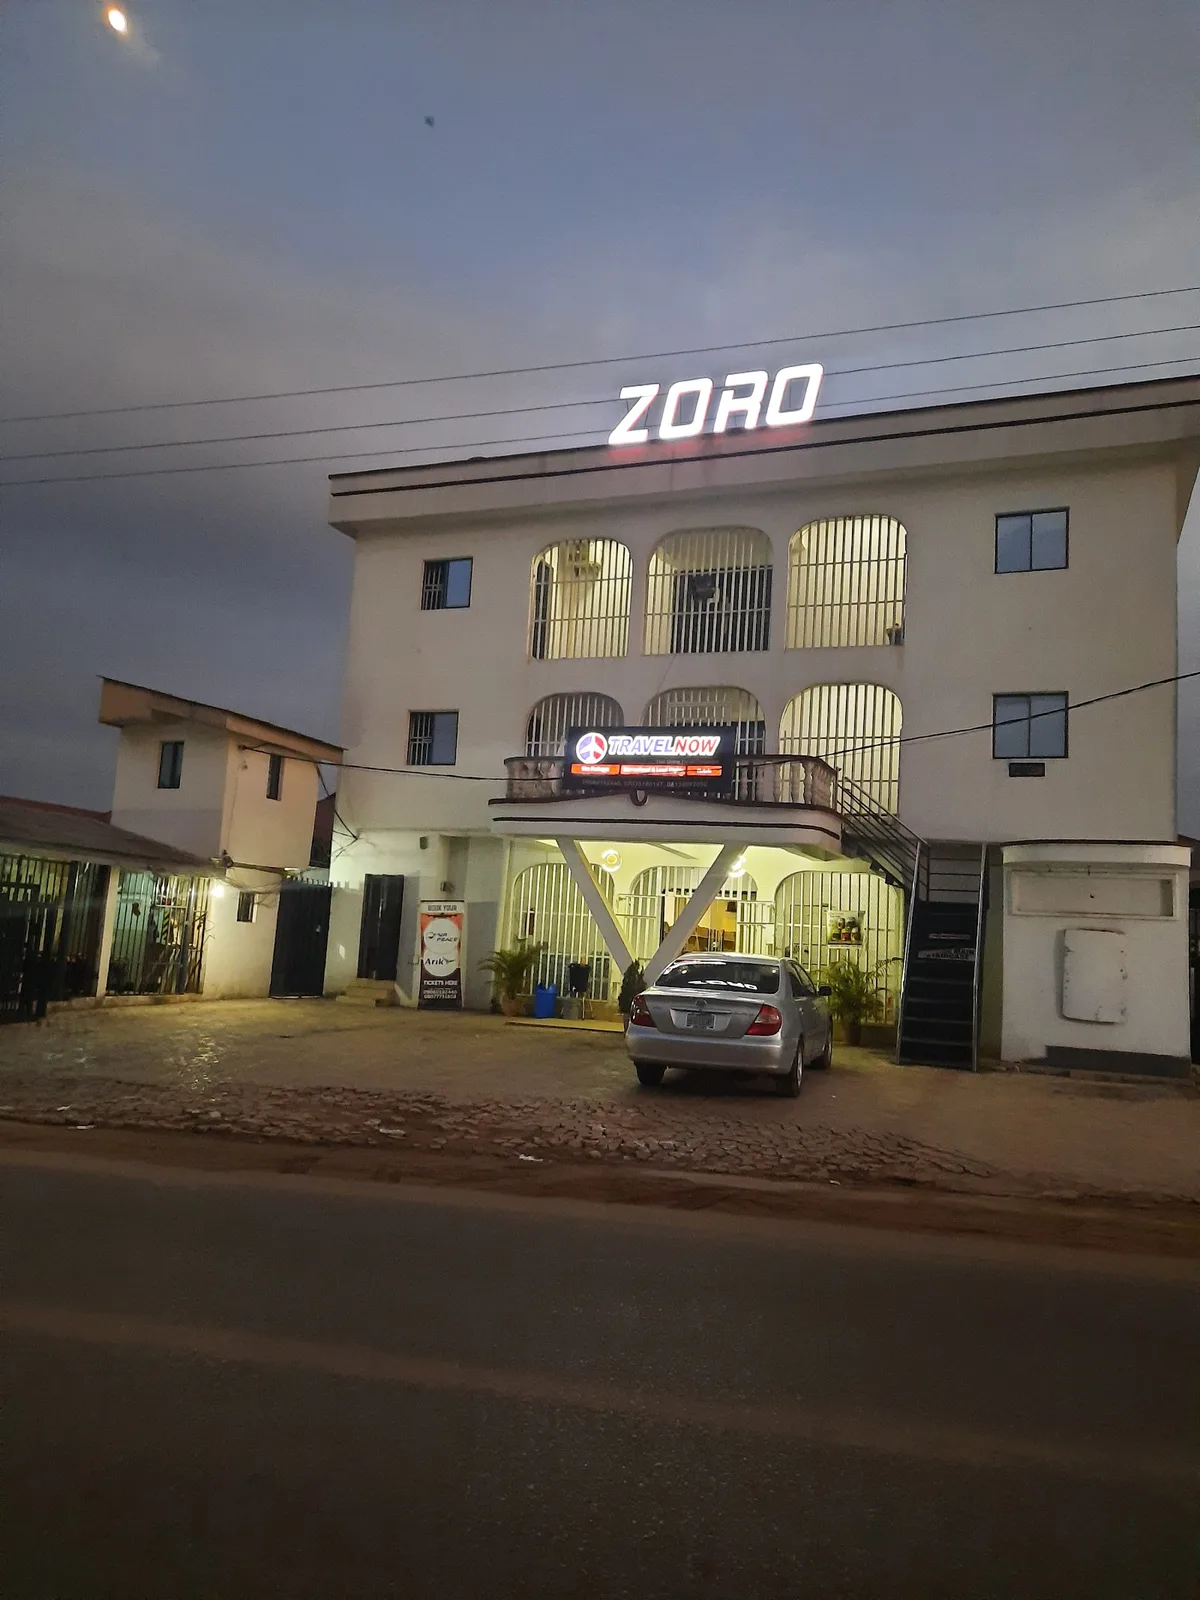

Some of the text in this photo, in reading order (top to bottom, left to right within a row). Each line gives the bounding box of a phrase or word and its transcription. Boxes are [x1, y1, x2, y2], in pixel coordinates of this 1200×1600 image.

[608, 363, 824, 445] ZORO
[608, 736, 721, 756] TRAVELNOW
[425, 957, 444, 965] Arik
